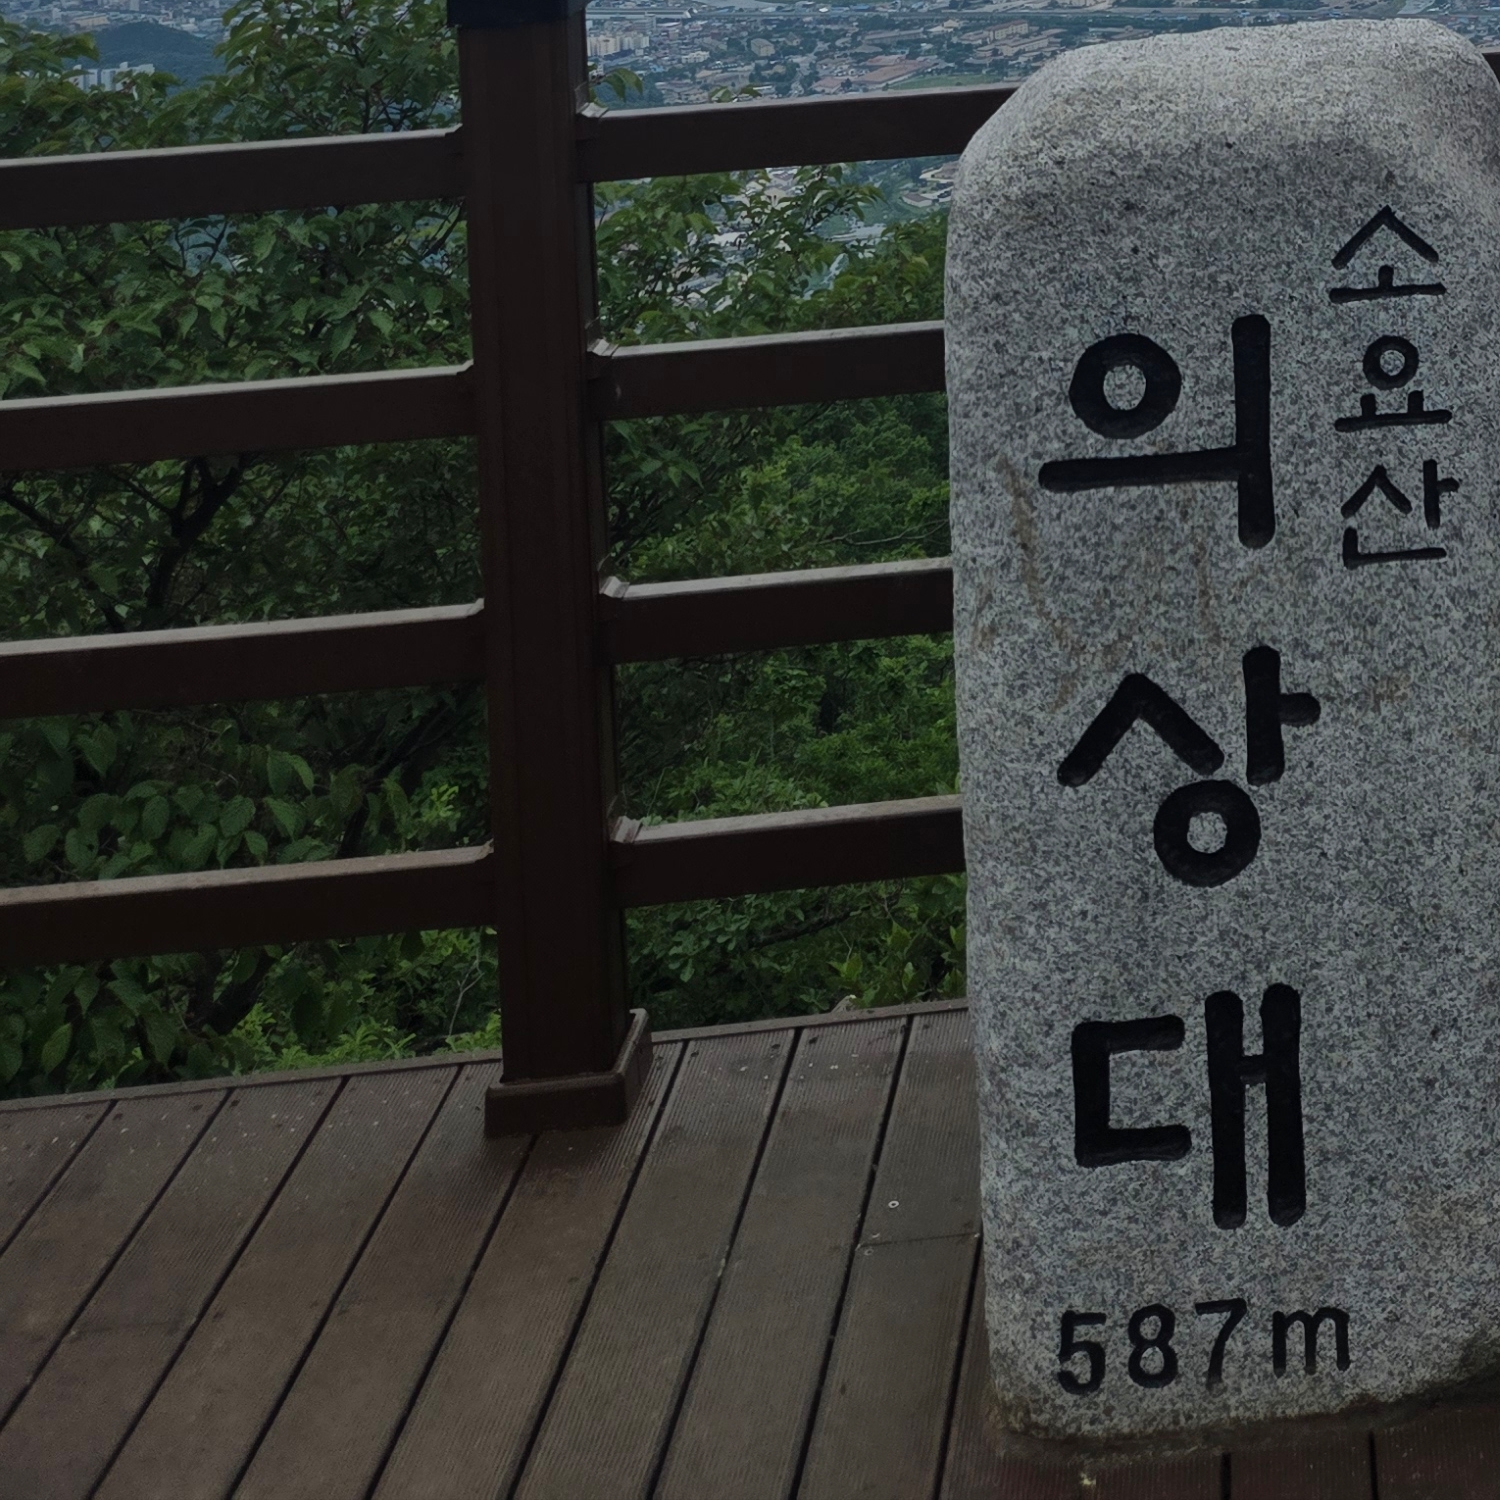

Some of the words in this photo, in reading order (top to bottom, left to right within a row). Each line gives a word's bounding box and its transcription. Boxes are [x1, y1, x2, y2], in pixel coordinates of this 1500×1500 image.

[1329, 204, 1460, 570] 소요산
[1038, 313, 1321, 1230] 의상대
[1056, 1297, 1351, 1396] 587m
